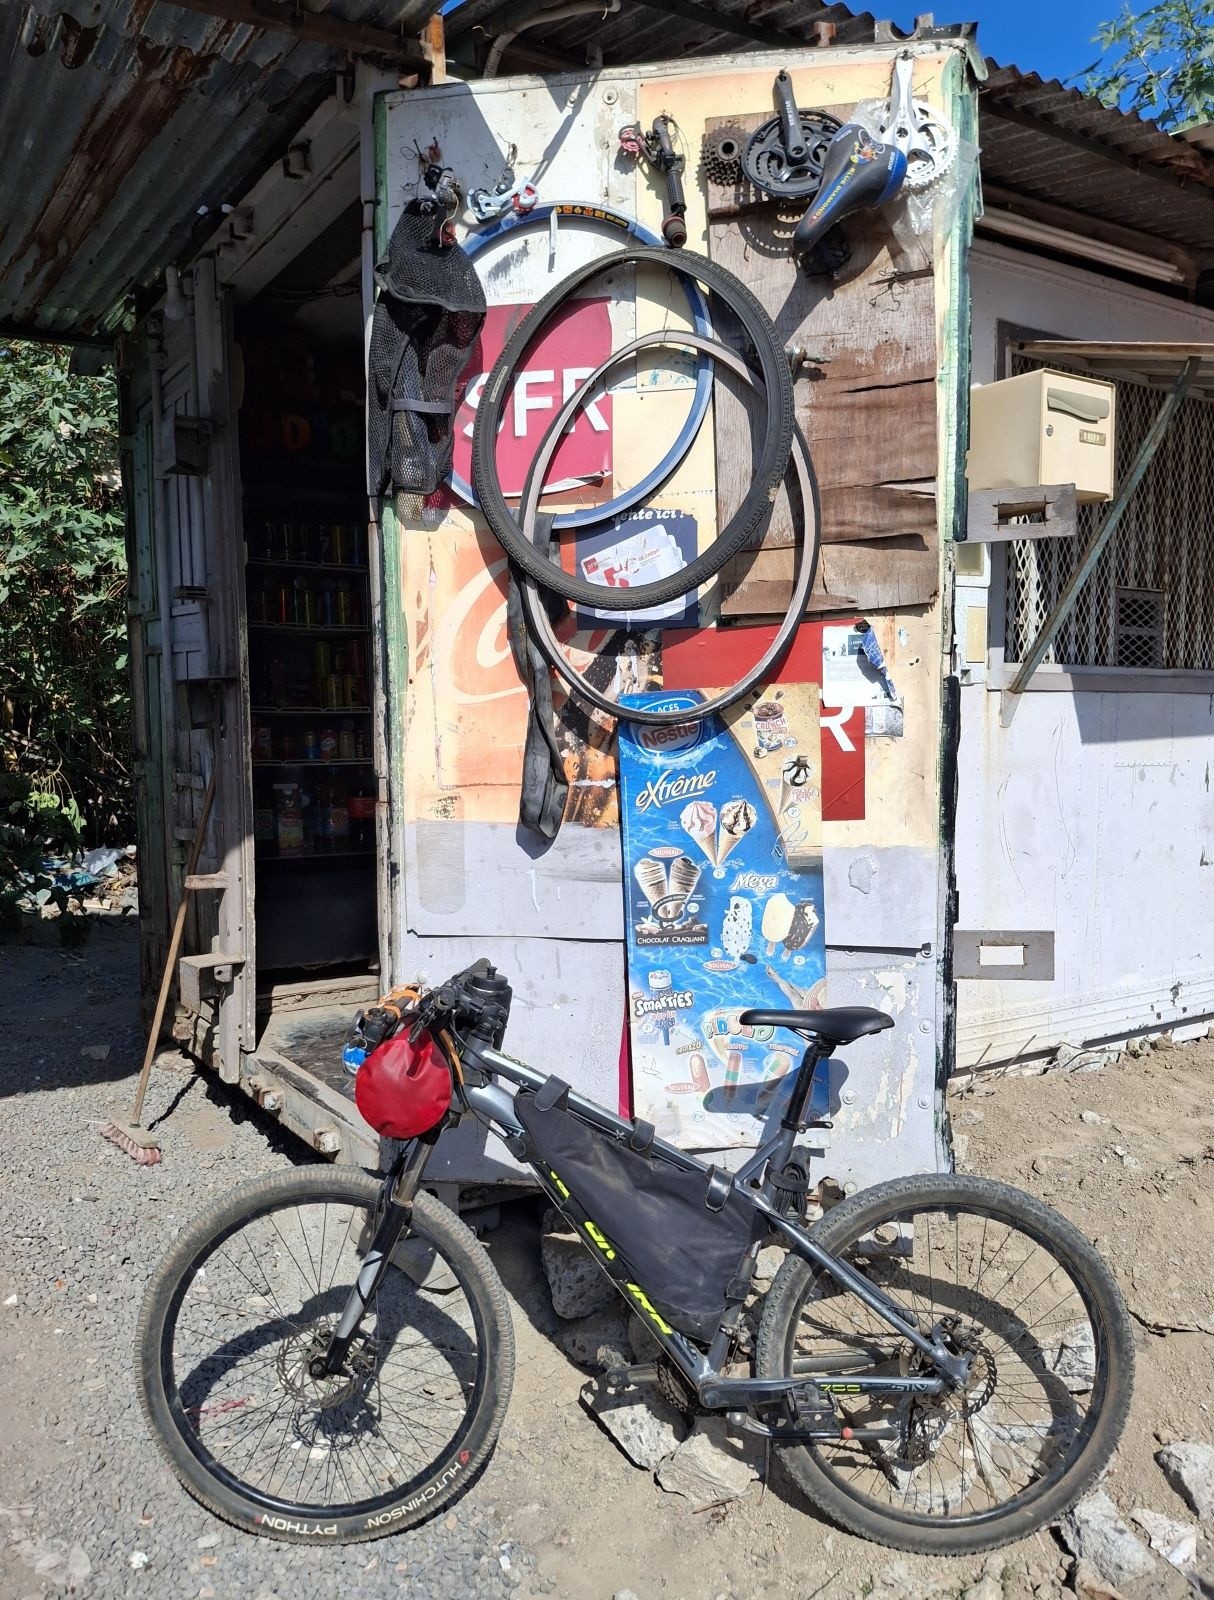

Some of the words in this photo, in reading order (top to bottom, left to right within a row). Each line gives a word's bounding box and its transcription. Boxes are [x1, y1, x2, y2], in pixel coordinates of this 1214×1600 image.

[841, 167, 856, 185] BLUE
[815, 187, 840, 217] DIAMOND
[655, 509, 676, 520] ici
[755, 717, 787, 730] CRUNCH
[730, 872, 778, 894] Mega
[636, 991, 693, 1017] SMARTIES
[367, 1461, 462, 1528] HUTCHINSON
[261, 1513, 338, 1536] PYTHON
